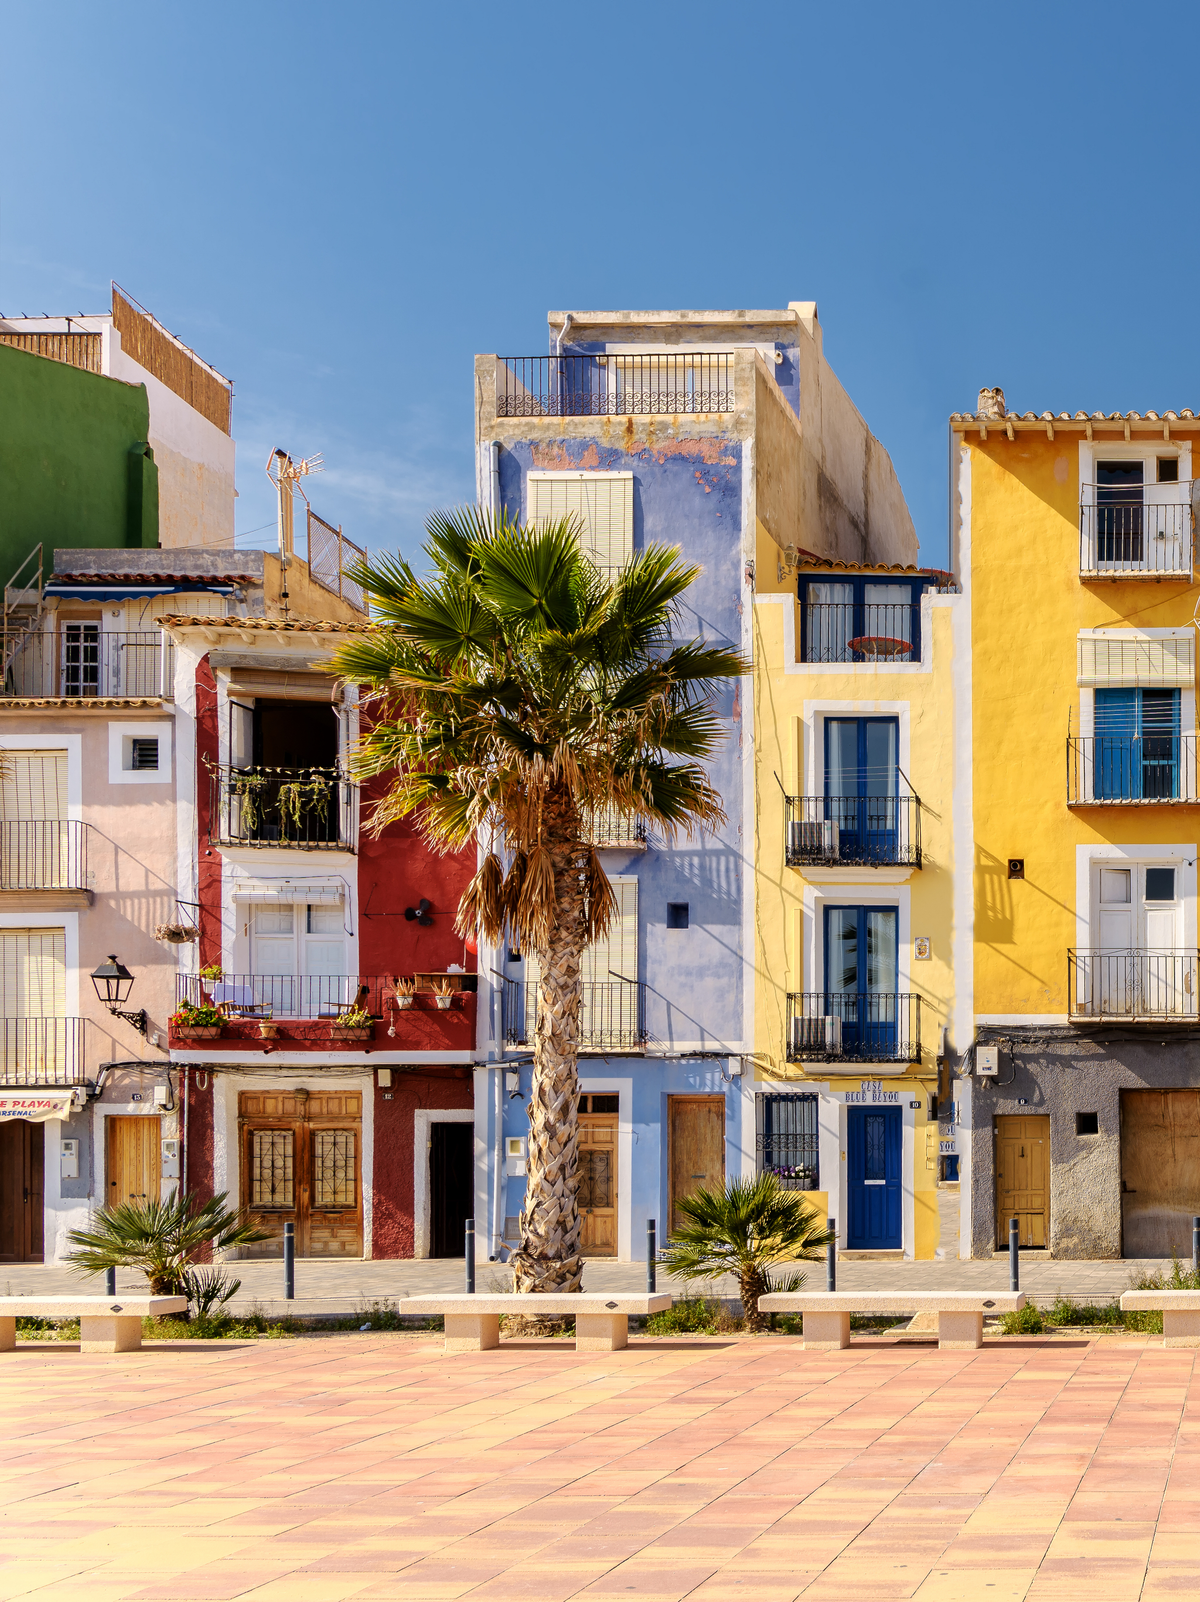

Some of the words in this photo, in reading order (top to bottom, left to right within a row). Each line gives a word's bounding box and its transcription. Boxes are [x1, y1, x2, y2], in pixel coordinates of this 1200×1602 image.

[861, 1081, 883, 1091] CASA
[845, 1092, 867, 1102] BLUE
[872, 1092, 899, 1102] BAYOU
[12, 1100, 51, 1109] PLAYA
